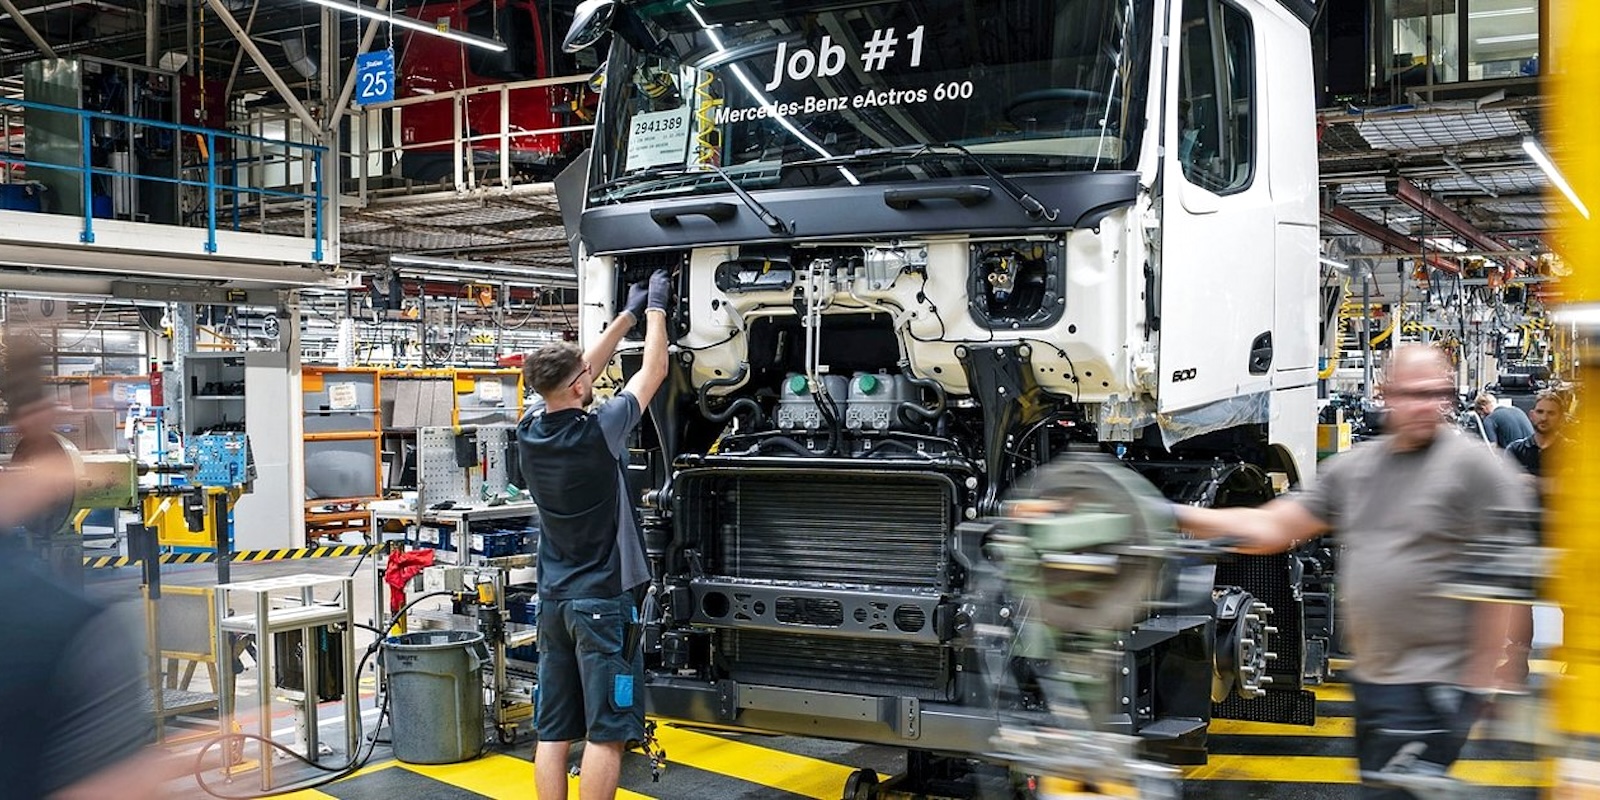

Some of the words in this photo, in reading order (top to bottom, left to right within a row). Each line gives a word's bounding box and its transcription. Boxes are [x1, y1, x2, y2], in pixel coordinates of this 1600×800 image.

[766, 36, 846, 92] Job
[362, 71, 387, 97] 25
[714, 96, 848, 124] Mercedes-Benz
[852, 88, 928, 108] eActros
[933, 80, 974, 101] 600
[635, 117, 682, 135] 2941389
[1172, 367, 1197, 382] 600
